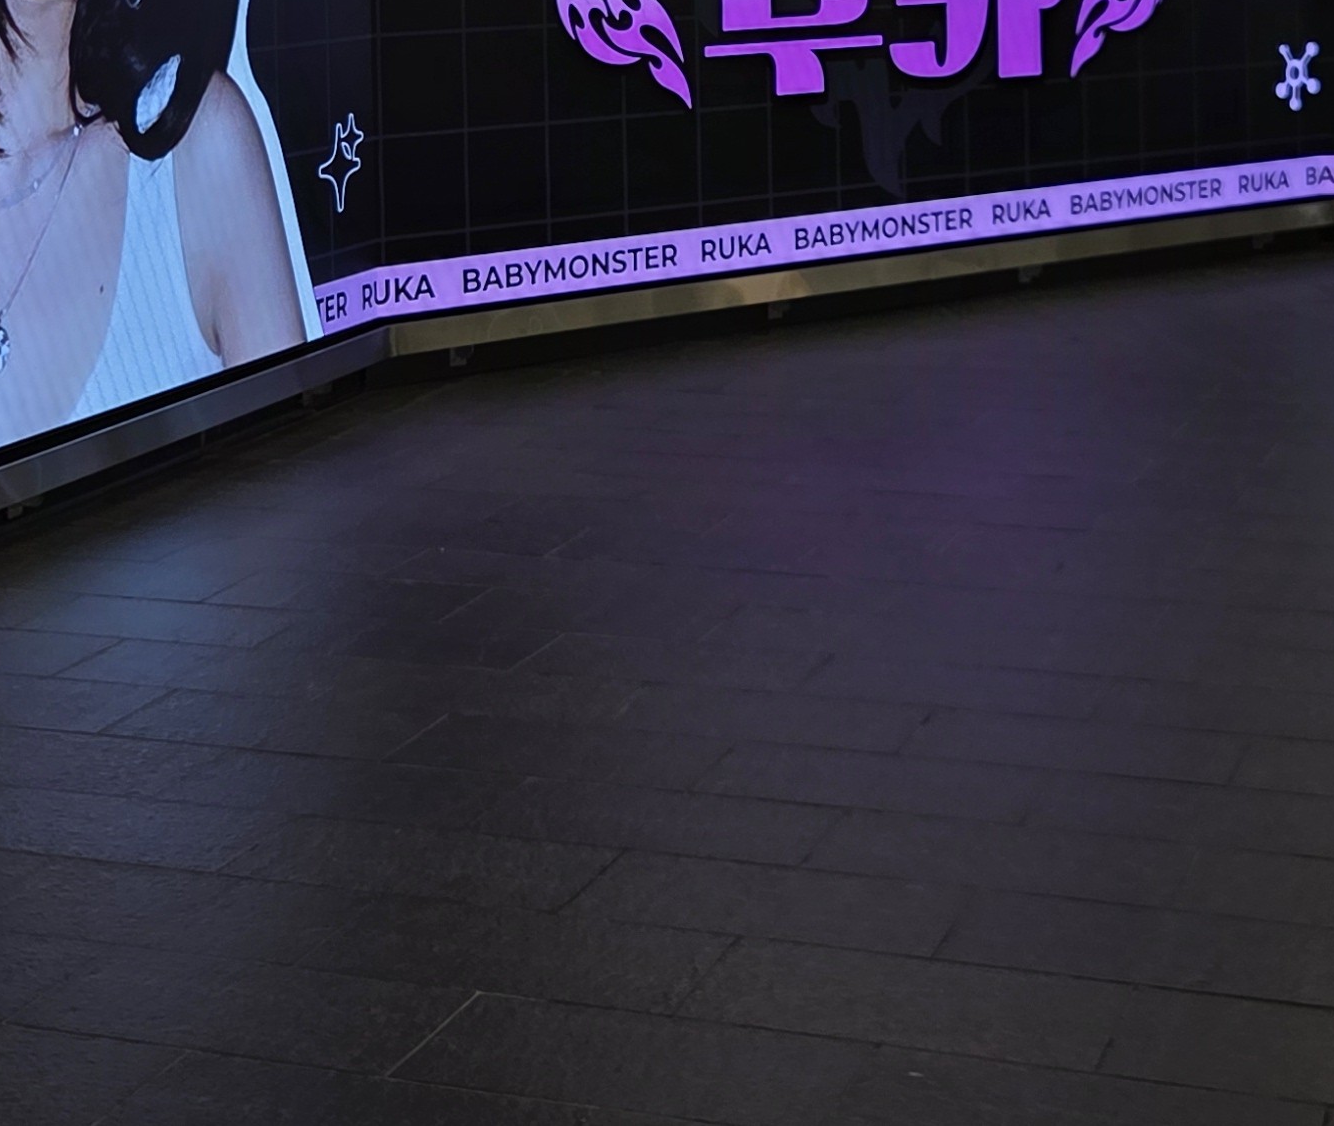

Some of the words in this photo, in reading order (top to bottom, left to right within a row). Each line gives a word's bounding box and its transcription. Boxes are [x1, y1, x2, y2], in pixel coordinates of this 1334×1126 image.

[362, 274, 435, 310] RUKA
[462, 243, 678, 295] BABYMONSTER
[700, 232, 772, 264] RUKA
[794, 208, 973, 250] BABYMONSTER
[991, 198, 1051, 225] RUKA
[1069, 178, 1222, 215] BABYMONSTER
[1238, 170, 1290, 194] RUKA
